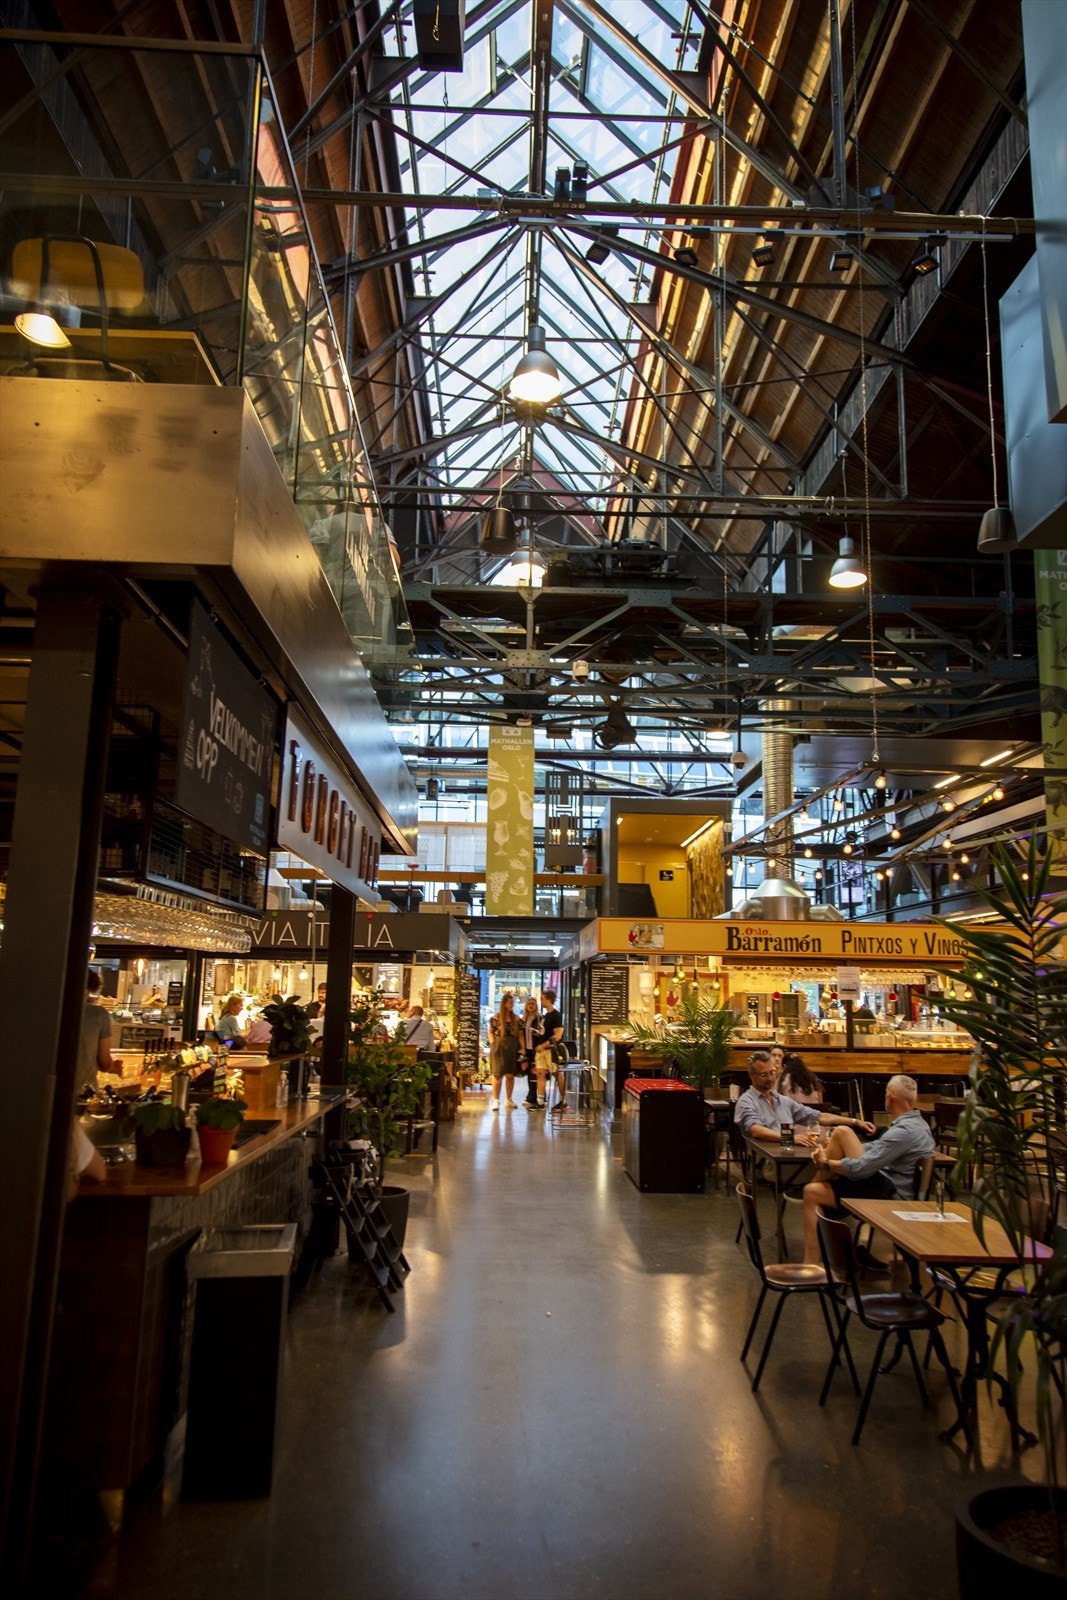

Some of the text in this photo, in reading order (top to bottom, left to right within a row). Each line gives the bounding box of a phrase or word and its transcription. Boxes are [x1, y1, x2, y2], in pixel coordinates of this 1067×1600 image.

[196, 728, 219, 784] OPP
[209, 691, 264, 777] VELKOMMEN
[725, 927, 822, 953] Barramón
